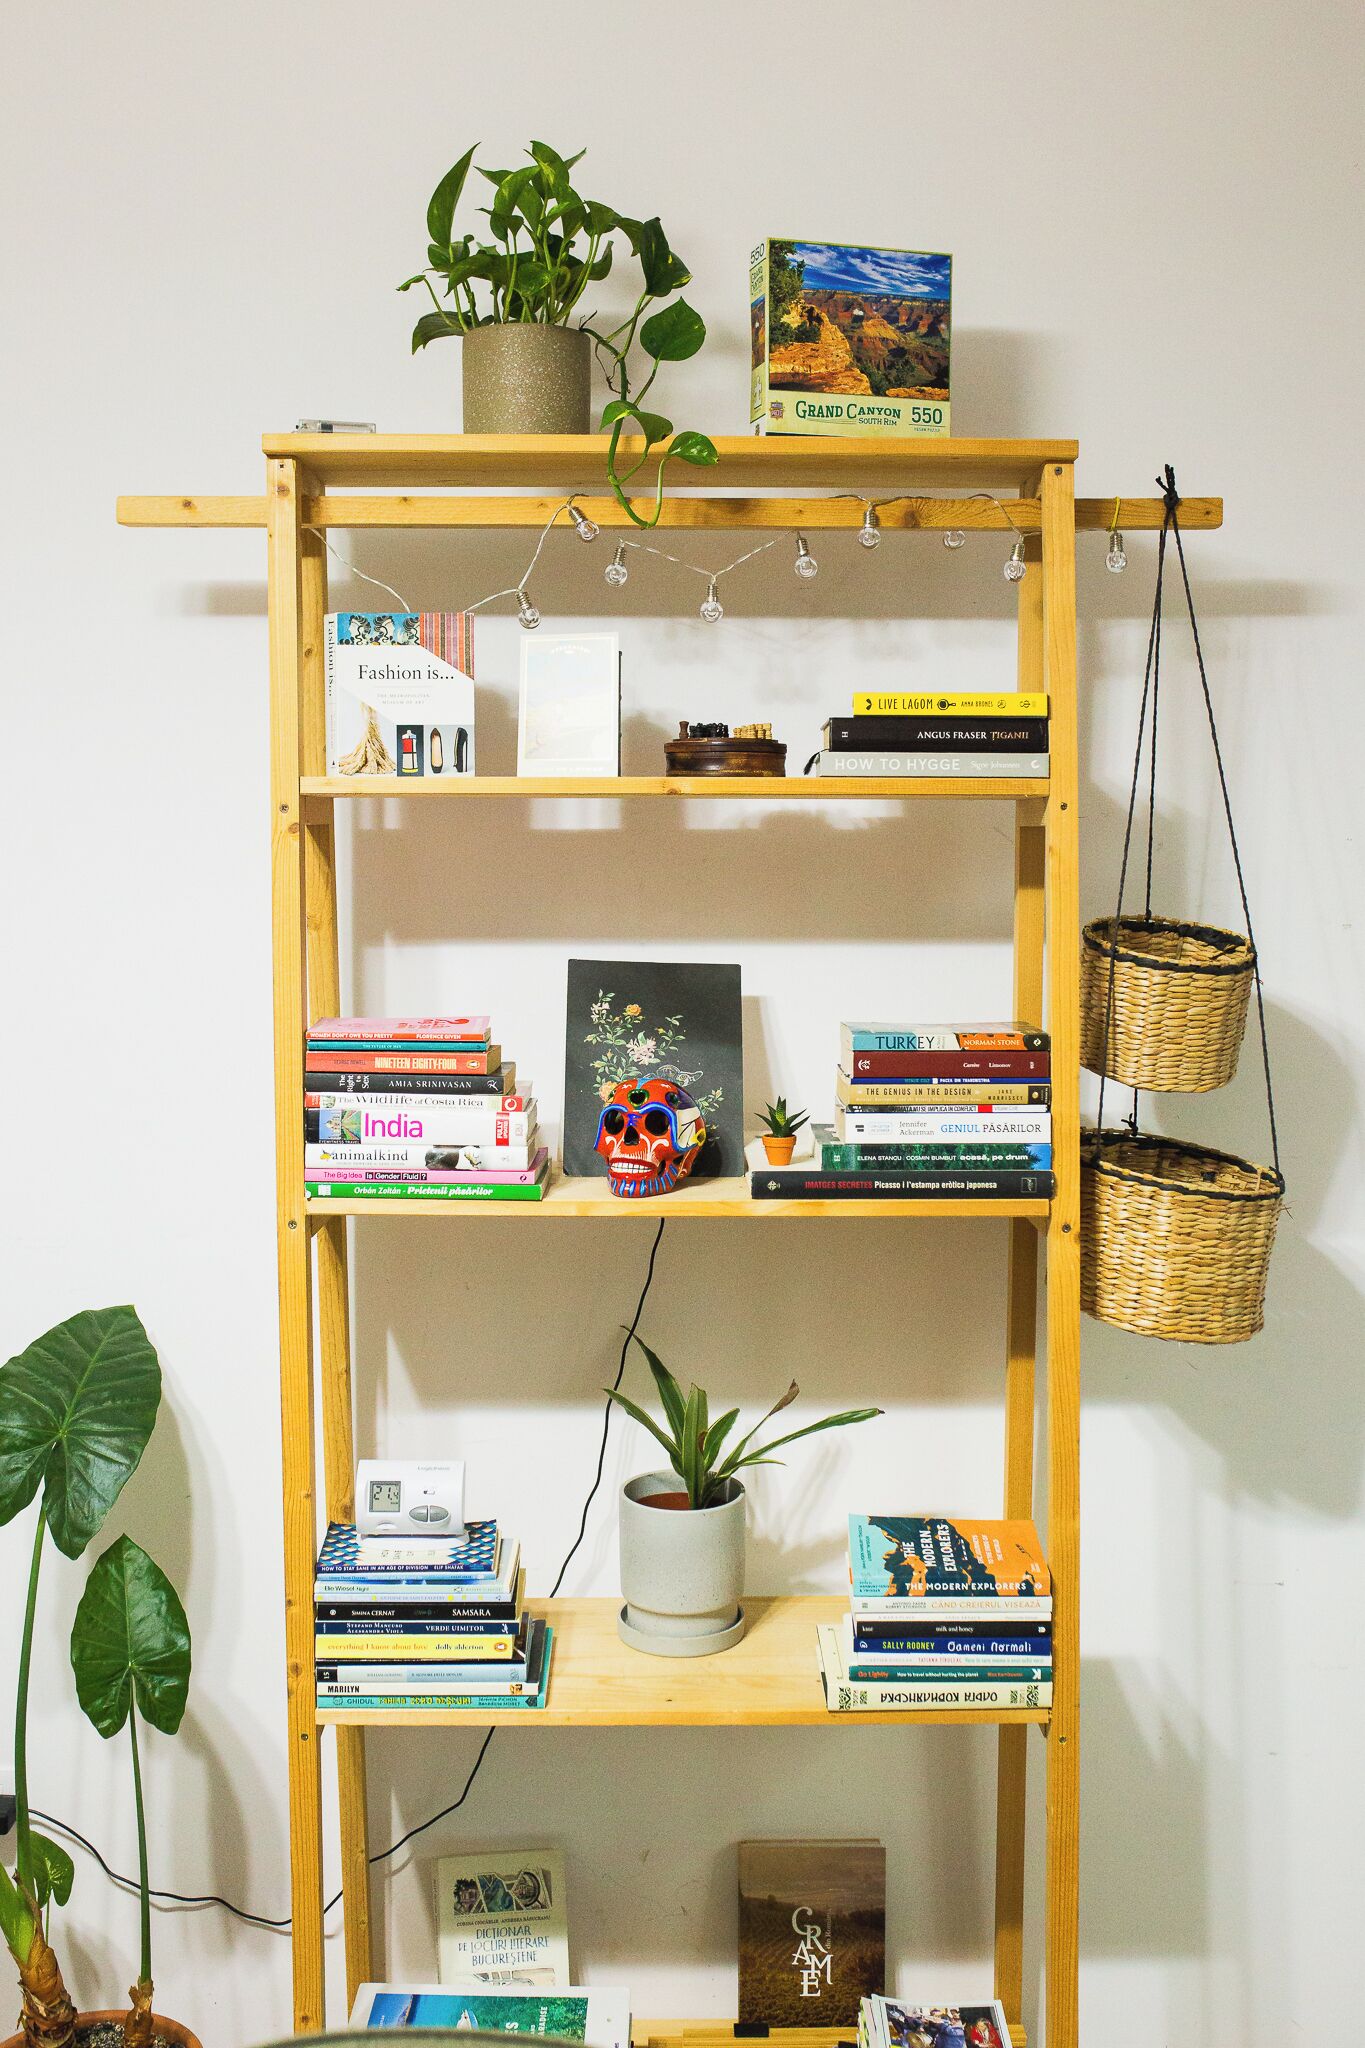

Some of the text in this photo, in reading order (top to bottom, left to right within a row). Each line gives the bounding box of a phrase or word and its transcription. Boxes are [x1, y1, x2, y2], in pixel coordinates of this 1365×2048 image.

[750, 243, 765, 264] 550
[796, 401, 843, 420] GRAND
[847, 404, 902, 420] CANYON
[912, 407, 942, 424] 550
[358, 664, 454, 680] Fashion is...
[878, 699, 898, 710] LIVE
[903, 699, 933, 710] LAGOM
[835, 759, 874, 770] HOW
[880, 759, 900, 770] TO
[907, 759, 960, 771] HYGGE
[876, 1036, 935, 1049] TURKEY
[375, 1057, 456, 1070] NINETEEN EIGHTY-FOUR
[356, 1095, 413, 1104] Wildlife
[424, 1097, 456, 1106] Costa
[458, 1098, 483, 1106] Rica
[364, 1112, 423, 1138] India
[983, 1124, 1042, 1133] PĂSĂRILOR
[332, 1150, 408, 1161] animalkind
[407, 1187, 447, 1195] Prietenii
[906, 1181, 940, 1190] l'estampa
[966, 1181, 997, 1190] japonesa
[901, 1541, 915, 1558] THE
[919, 1530, 937, 1567] MODERN
[937, 1524, 957, 1572] EXPLORERS
[436, 1643, 452, 1651] dolly
[882, 1641, 903, 1650] SALLY
[948, 1642, 985, 1652] Oameni
[991, 1642, 1031, 1652] Normali
[868, 1670, 889, 1679] Lightly
[965, 1691, 998, 1702] ОЛЬГА
[477, 1926, 531, 1939] DICȚIONAR
[459, 1943, 466, 1951] DE
[472, 1951, 536, 1966] BUCUREȘTENE
